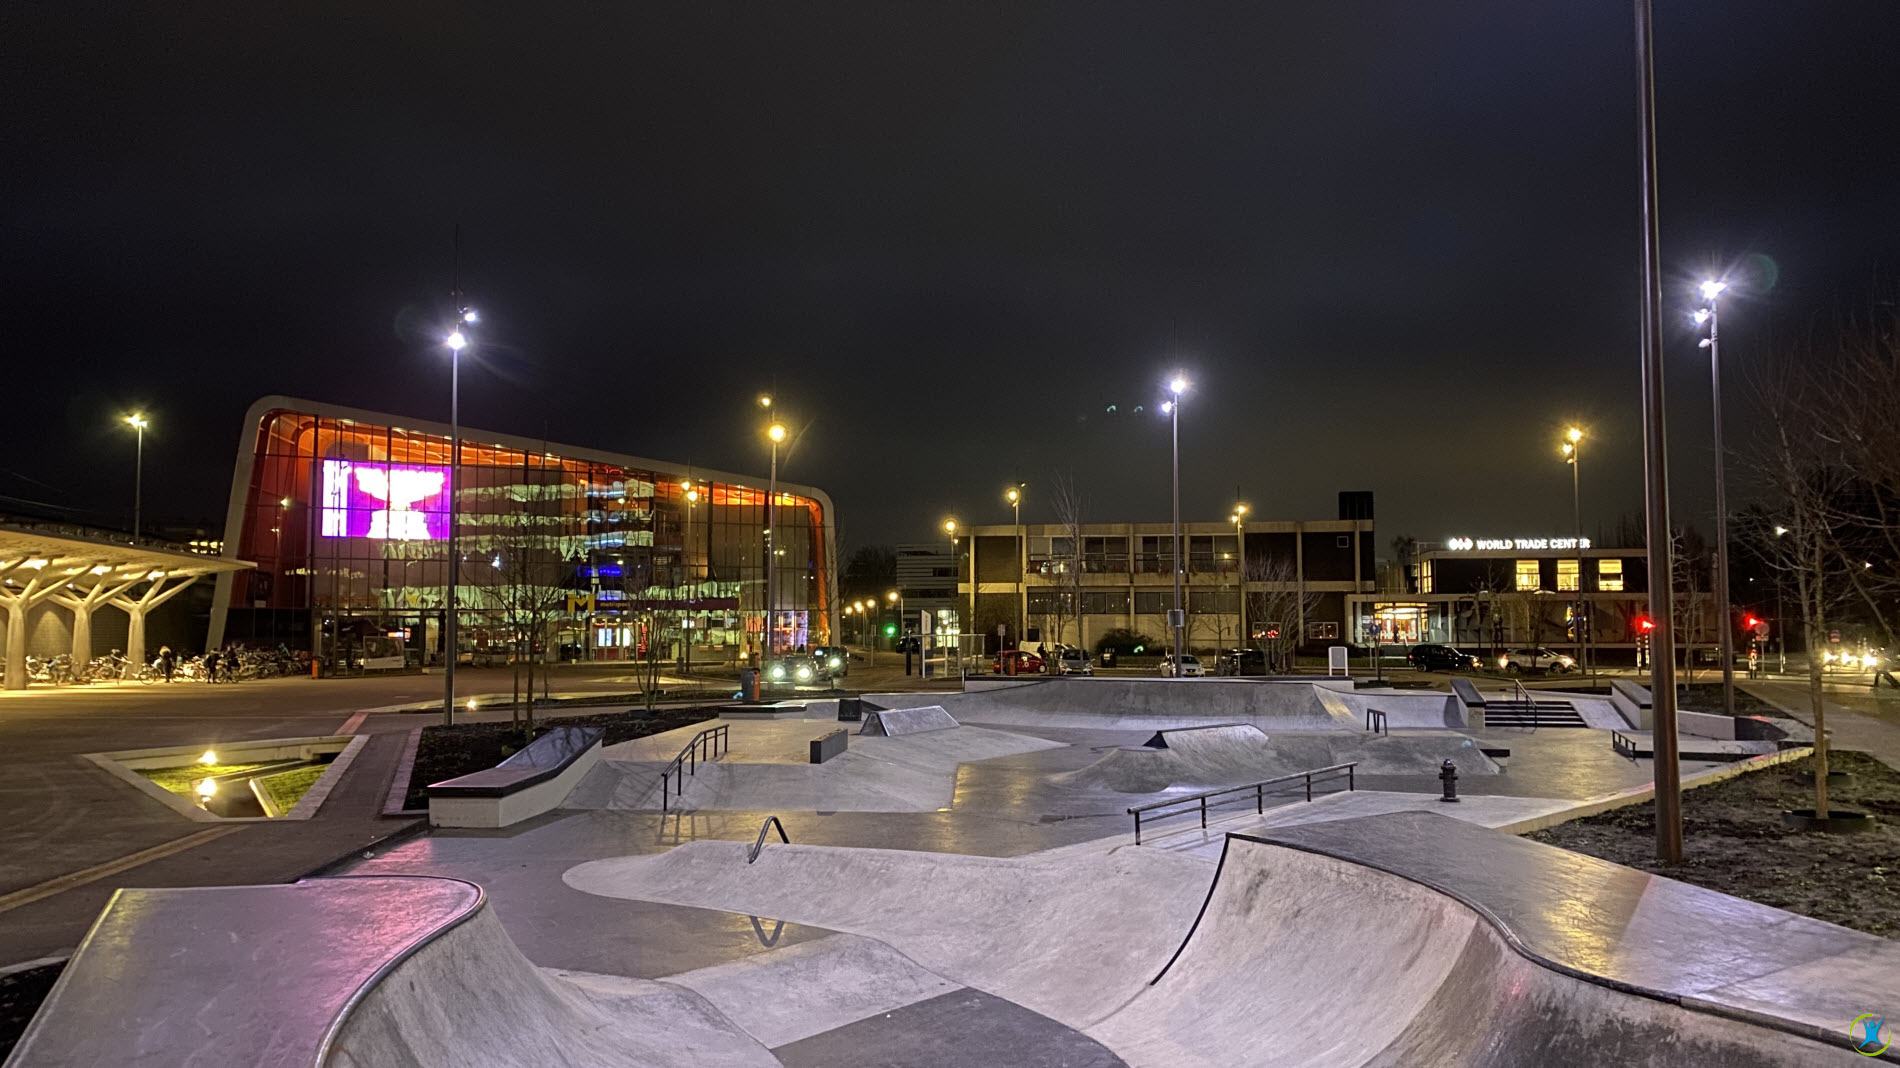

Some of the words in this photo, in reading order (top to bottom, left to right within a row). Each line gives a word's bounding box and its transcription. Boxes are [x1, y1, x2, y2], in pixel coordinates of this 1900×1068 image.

[1476, 539, 1513, 550] WORLD
[1515, 538, 1548, 549] TRADE
[1549, 538, 1590, 549] CENTER
